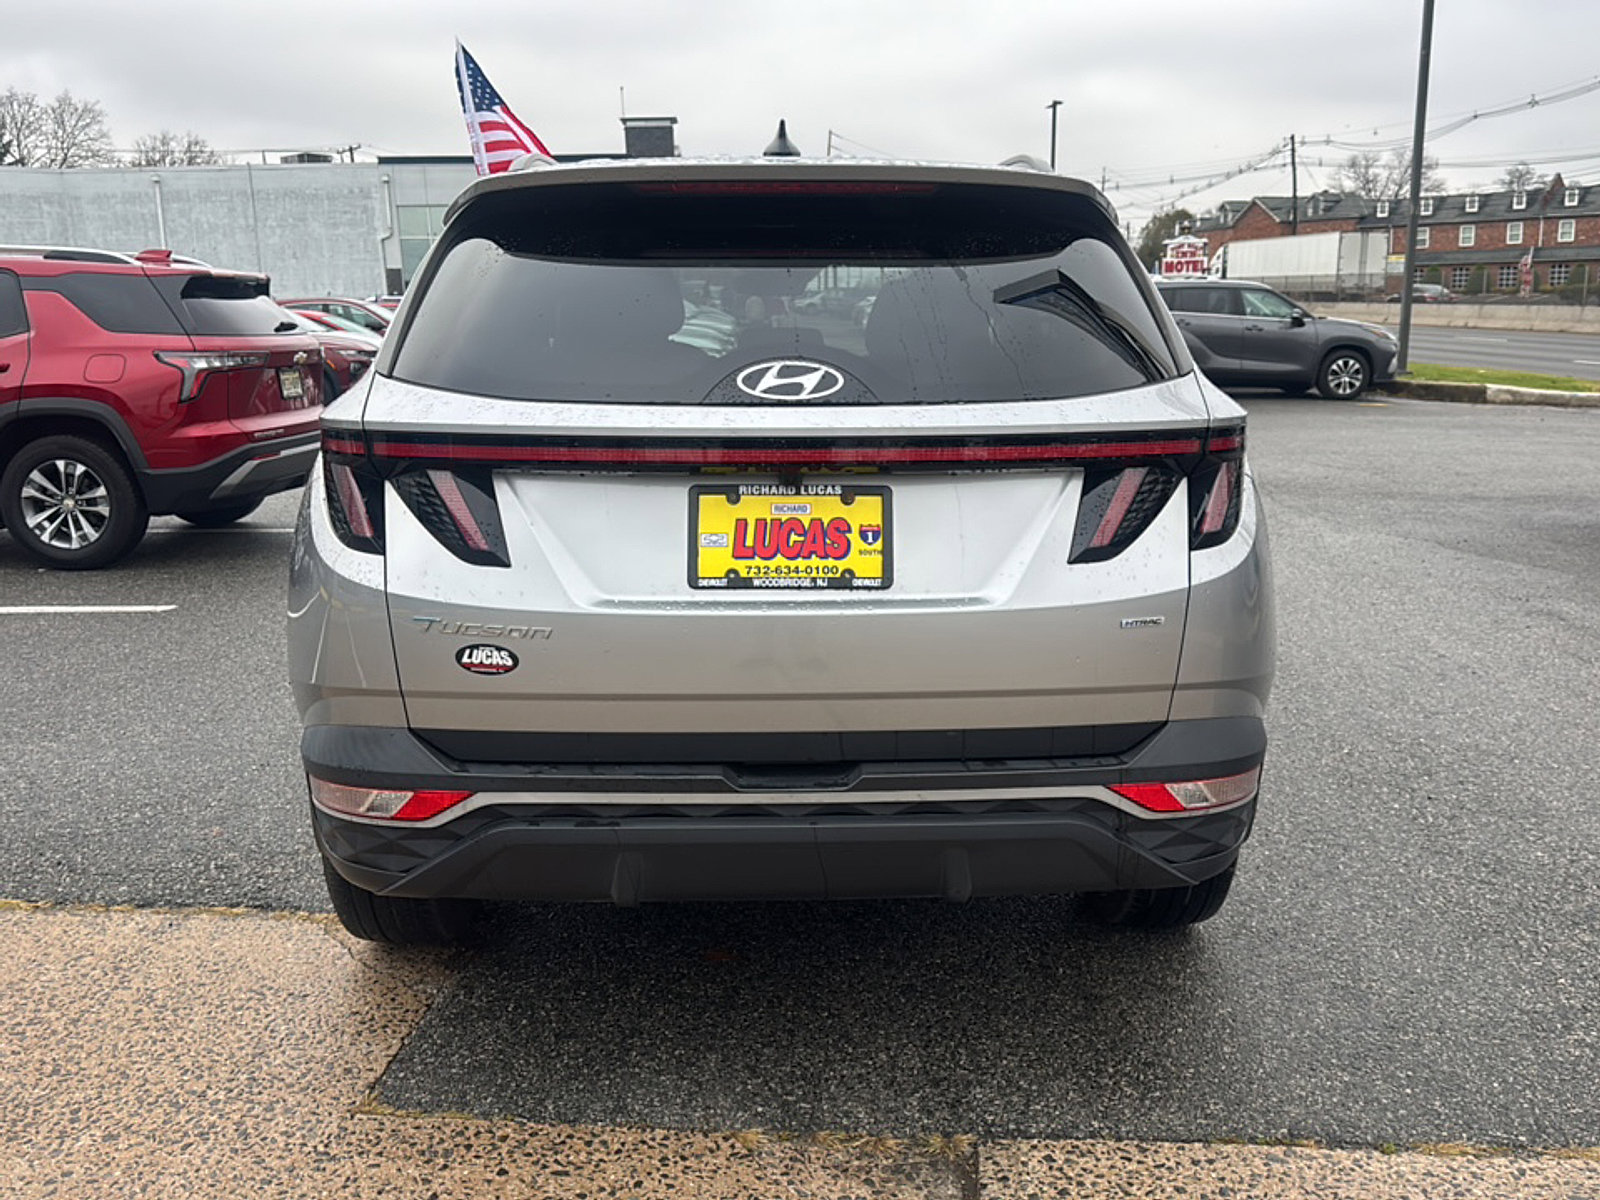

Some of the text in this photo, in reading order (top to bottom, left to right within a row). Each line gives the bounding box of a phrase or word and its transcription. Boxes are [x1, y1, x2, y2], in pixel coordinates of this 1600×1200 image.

[1164, 260, 1204, 273] MOTEL
[738, 485, 843, 495] RICHARD LUCAS
[773, 504, 809, 514] RICHARD
[732, 517, 852, 560] LUCAS
[866, 531, 873, 543] 1
[745, 565, 839, 576] 732-634-0100
[816, 577, 828, 587] NJ
[461, 648, 513, 666] LUCAS
